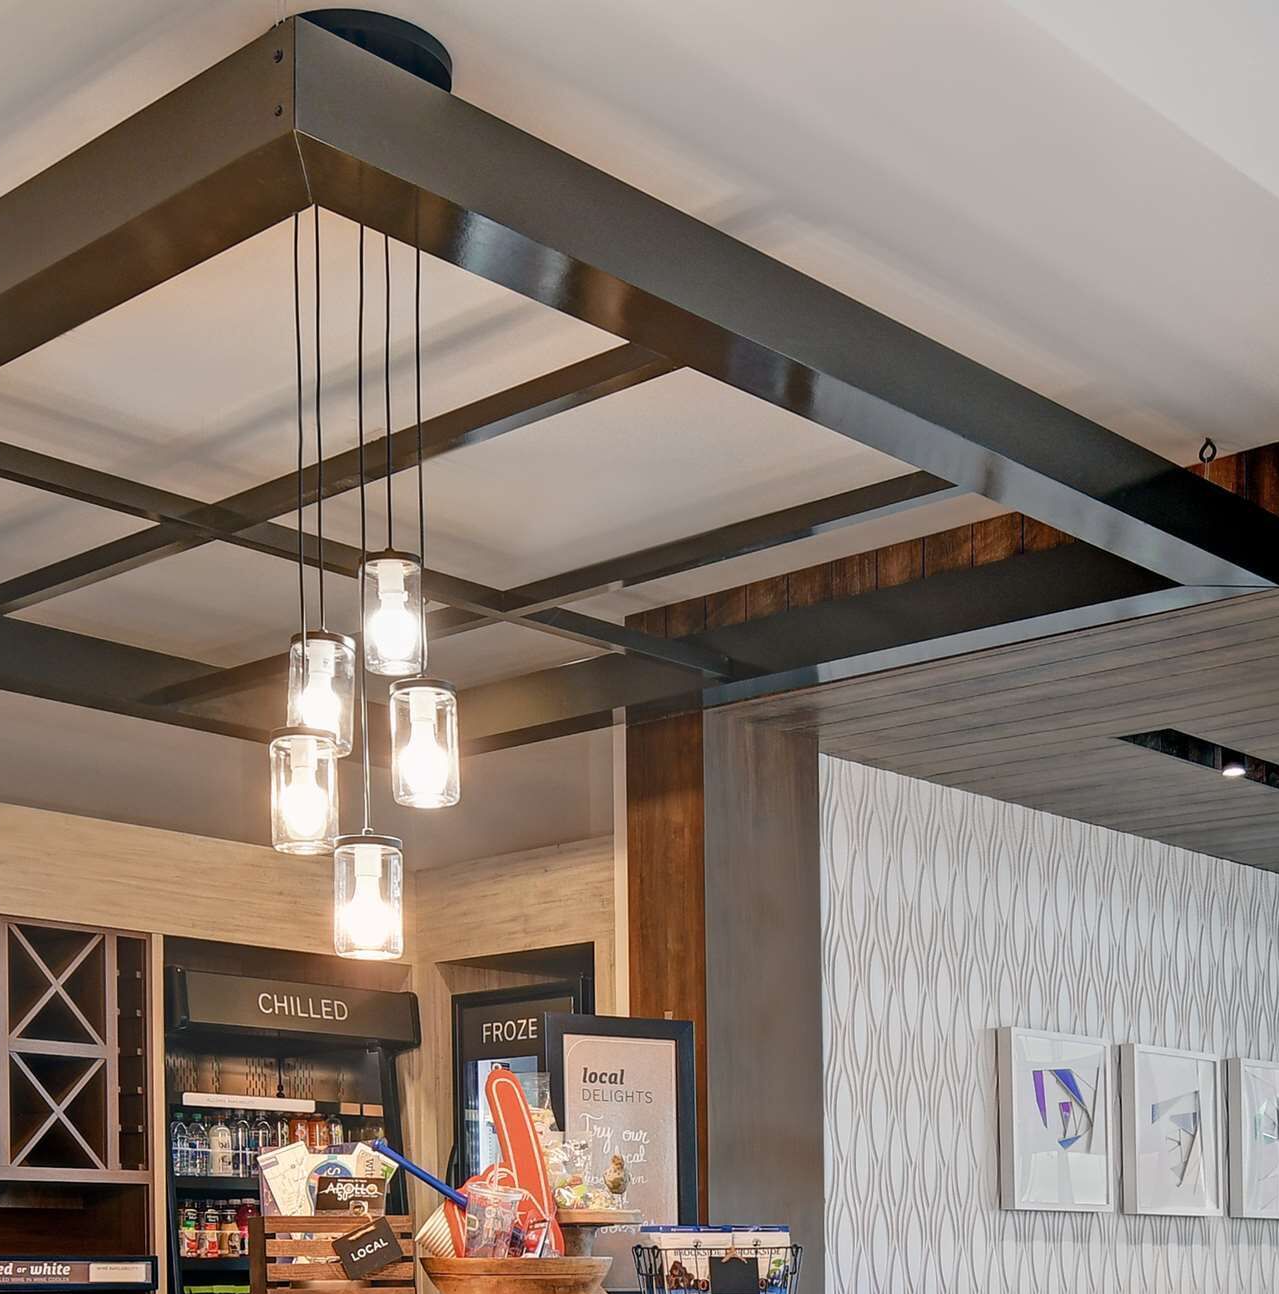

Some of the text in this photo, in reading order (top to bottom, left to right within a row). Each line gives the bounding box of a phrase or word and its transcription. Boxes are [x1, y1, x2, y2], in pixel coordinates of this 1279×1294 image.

[257, 993, 348, 1021] CHILLED
[482, 1018, 538, 1044] FROZE
[582, 1068, 624, 1085] local
[582, 1089, 653, 1104] DELIGHTS
[579, 1113, 650, 1153] Try our
[328, 1182, 378, 1195] APOLLO
[350, 1238, 389, 1262] LOCAL
[30, 1263, 71, 1275] white
